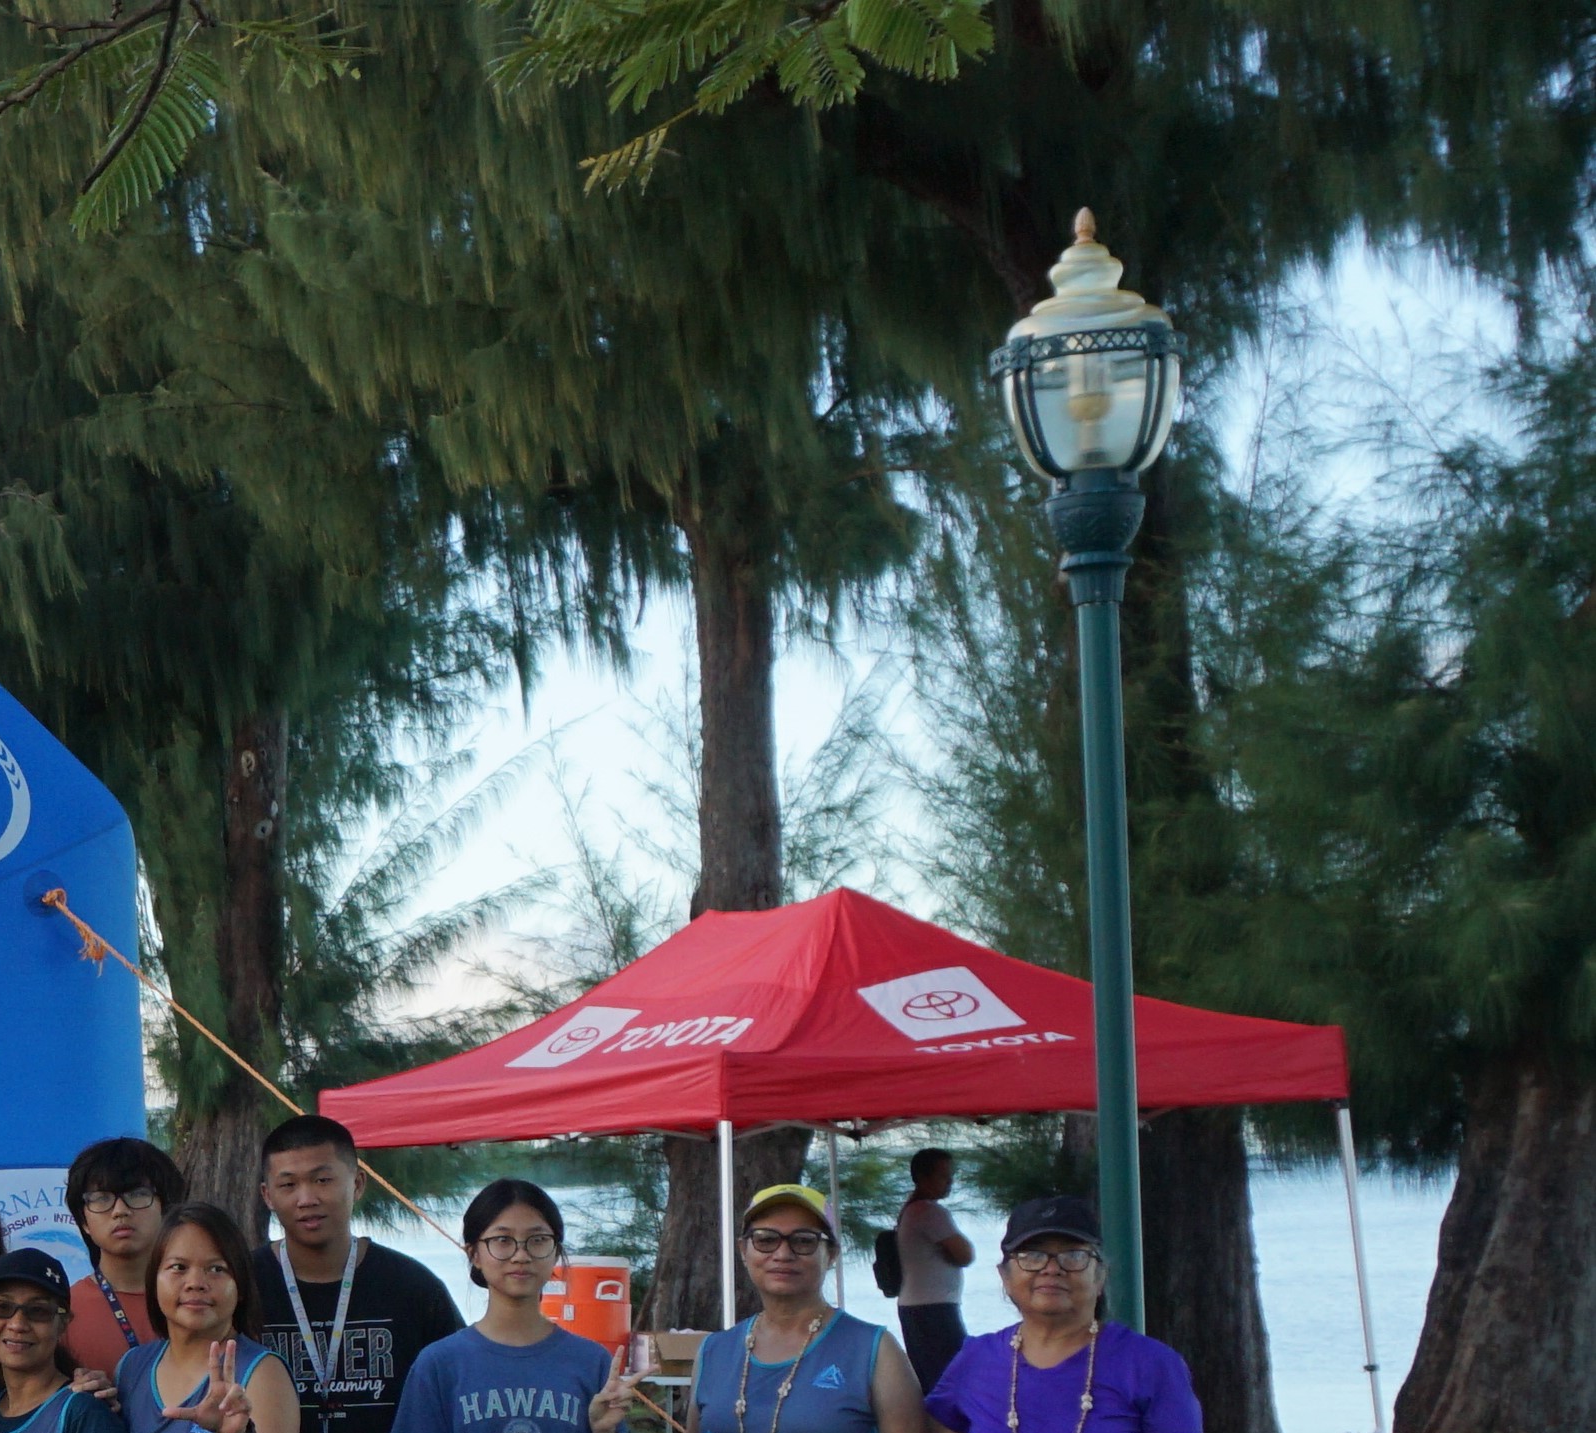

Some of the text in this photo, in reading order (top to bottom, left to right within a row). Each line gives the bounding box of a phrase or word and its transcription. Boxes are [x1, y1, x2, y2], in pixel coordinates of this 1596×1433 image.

[603, 1016, 754, 1054] TOYOTA
[915, 1030, 1076, 1054] TOYOTA
[262, 1327, 394, 1381] NEVER
[459, 1387, 580, 1426] HAWAII
